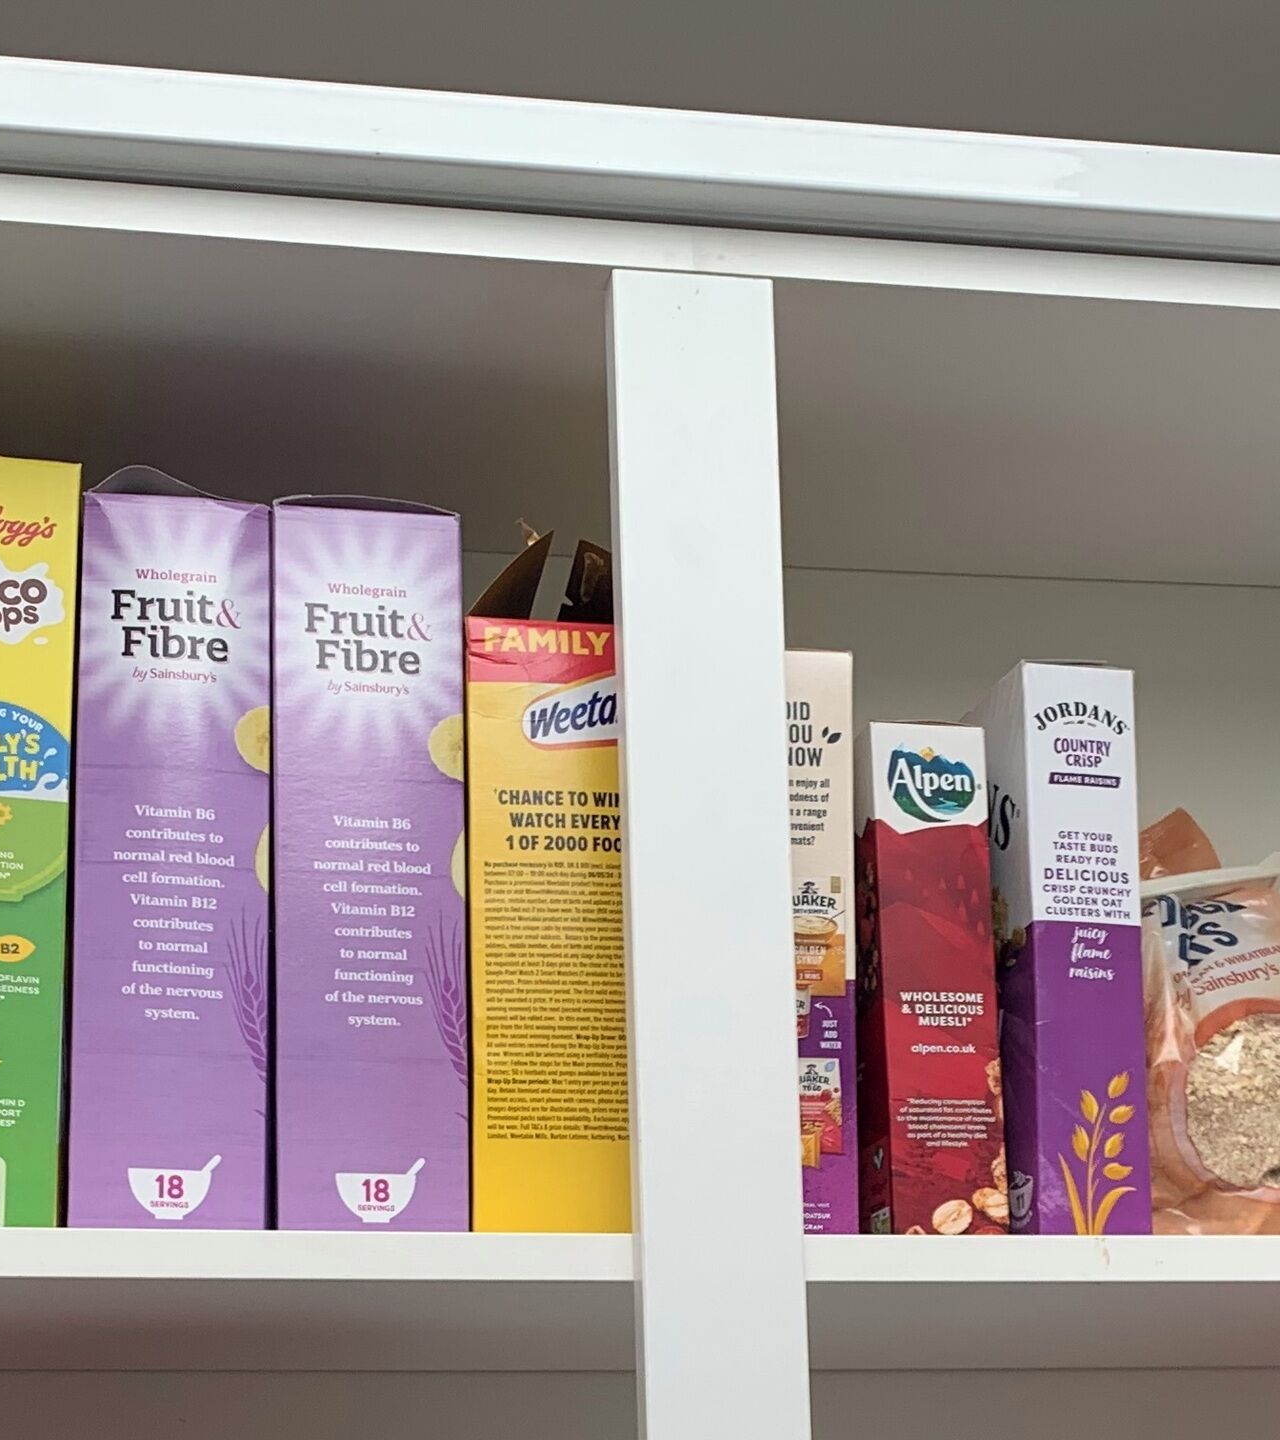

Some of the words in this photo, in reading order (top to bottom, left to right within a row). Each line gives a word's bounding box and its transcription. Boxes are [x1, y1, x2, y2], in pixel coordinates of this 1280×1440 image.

[136, 568, 217, 584] Wholegrain
[328, 582, 407, 598] Wholegrain
[111, 589, 213, 624] Fruit
[216, 599, 242, 629] &
[305, 602, 404, 639] Fruit
[407, 613, 432, 642] &
[121, 625, 229, 663] Fibre
[484, 626, 611, 656] FAMILY
[316, 638, 420, 675] Fibre
[132, 666, 147, 682] by
[150, 668, 217, 683] Sainsbury's
[327, 680, 342, 695] by
[344, 681, 410, 696] Sainsbury's
[11, 711, 44, 733] YOUR
[530, 691, 618, 739] Weeta
[1034, 701, 1127, 735] JORDANS
[1054, 737, 1111, 757] COUNTRY
[795, 779, 818, 789] enjoy
[819, 779, 830, 788] all
[1053, 774, 1082, 784] FLAME
[1084, 776, 1117, 787] RAISINS
[890, 758, 972, 821] Alpen
[568, 791, 588, 806] TO
[135, 805, 192, 819] Vitamin
[196, 808, 215, 820] B6
[803, 808, 827, 818] range
[333, 815, 389, 829] Vitamin
[392, 818, 411, 830] B6
[510, 813, 566, 828] WATCH
[126, 828, 206, 842] contributes
[209, 832, 223, 843] to
[505, 835, 514, 850] 1
[519, 836, 539, 851] OF
[544, 836, 588, 851] 2000
[1058, 831, 1079, 840] GET
[1083, 832, 1113, 842] YOUR
[325, 838, 402, 851] contributes
[406, 841, 420, 852] to
[1053, 842, 1087, 851] TASTE
[1090, 844, 1119, 854] BUDS
[114, 850, 165, 862] normal
[169, 852, 192, 863] red
[196, 853, 235, 867] blood
[1056, 855, 1092, 864] READY
[1095, 856, 1117, 866] FOR
[314, 860, 364, 871] normal
[368, 862, 390, 872] red
[394, 862, 431, 875] blood
[122, 872, 148, 883] cell
[152, 872, 225, 888] formation.
[1044, 868, 1130, 884] DELICIOUS
[323, 881, 348, 892] cell
[351, 881, 422, 896] formation.
[1042, 884, 1076, 894] CRISP
[1079, 886, 1131, 898] CRUNCHY
[130, 894, 187, 907] Vitamin
[191, 897, 217, 909] B12
[1053, 896, 1098, 906] GOLDEN
[1102, 898, 1123, 907] OAT
[1045, 906, 1100, 917] CLUSTERS
[1103, 910, 1131, 919] WITH
[133, 917, 213, 932] contributes
[1072, 926, 1109, 944] juicy
[0, 944, 20, 954] B2
[139, 940, 153, 950] to
[157, 942, 208, 953] normal
[1071, 943, 1112, 963] flame
[132, 960, 214, 979] functioning
[1069, 967, 1115, 981] raisins
[1192, 962, 1280, 996] Sainsbury's
[122, 983, 136, 994] of
[139, 984, 162, 995] the
[166, 986, 223, 999] nervous
[900, 992, 984, 1003] WHOLESOME
[145, 1006, 200, 1020] system.
[901, 1004, 912, 1014] &
[915, 1004, 984, 1015] DELICIOUS
[822, 1020, 838, 1028] JUST
[911, 1044, 976, 1055] alpen.co.uk
[18, 1099, 25, 1107] D
[155, 1175, 184, 1199] 18
[361, 1178, 390, 1202] 18
[150, 1200, 189, 1209] SERVINGS
[358, 1204, 395, 1213] SERVINGS
